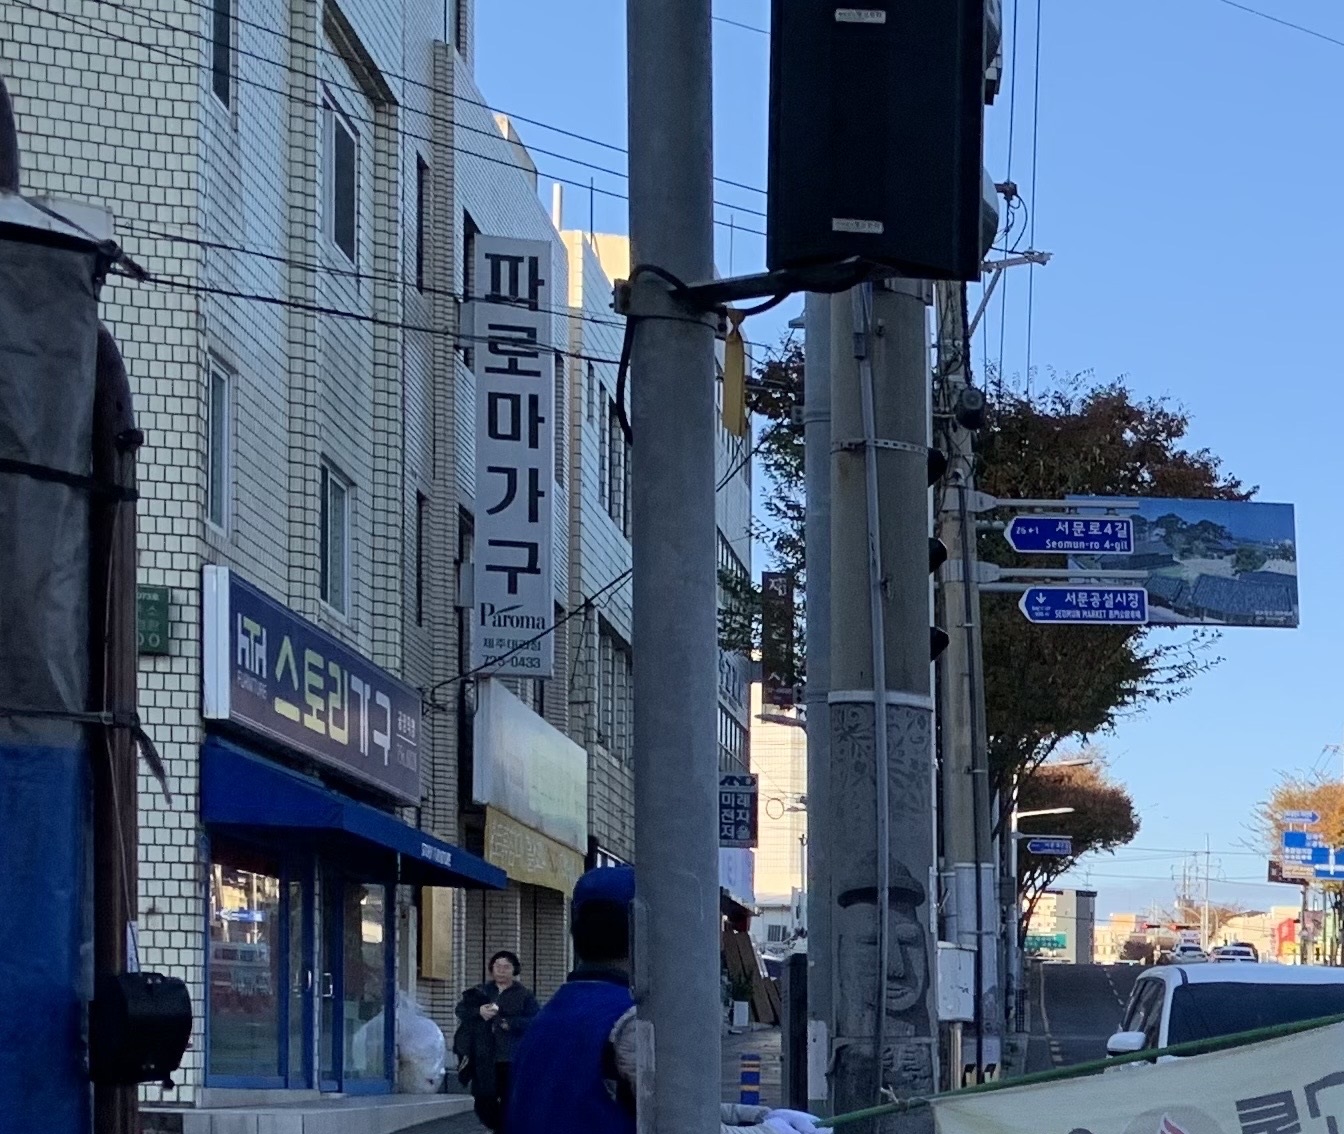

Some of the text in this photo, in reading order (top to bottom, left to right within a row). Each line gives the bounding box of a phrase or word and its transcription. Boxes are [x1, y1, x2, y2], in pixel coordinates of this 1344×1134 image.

[484, 252, 545, 594] 파로마가구
[1055, 521, 1128, 539] 서문로4길
[1045, 538, 1128, 552] Seomun-ro 4-gil
[1064, 592, 1139, 608] 서문공설시장
[480, 602, 546, 630] Paroma
[1054, 610, 1080, 619] SEOMUN
[1082, 610, 1107, 619] MARKET
[721, 793, 751, 808] 미래
